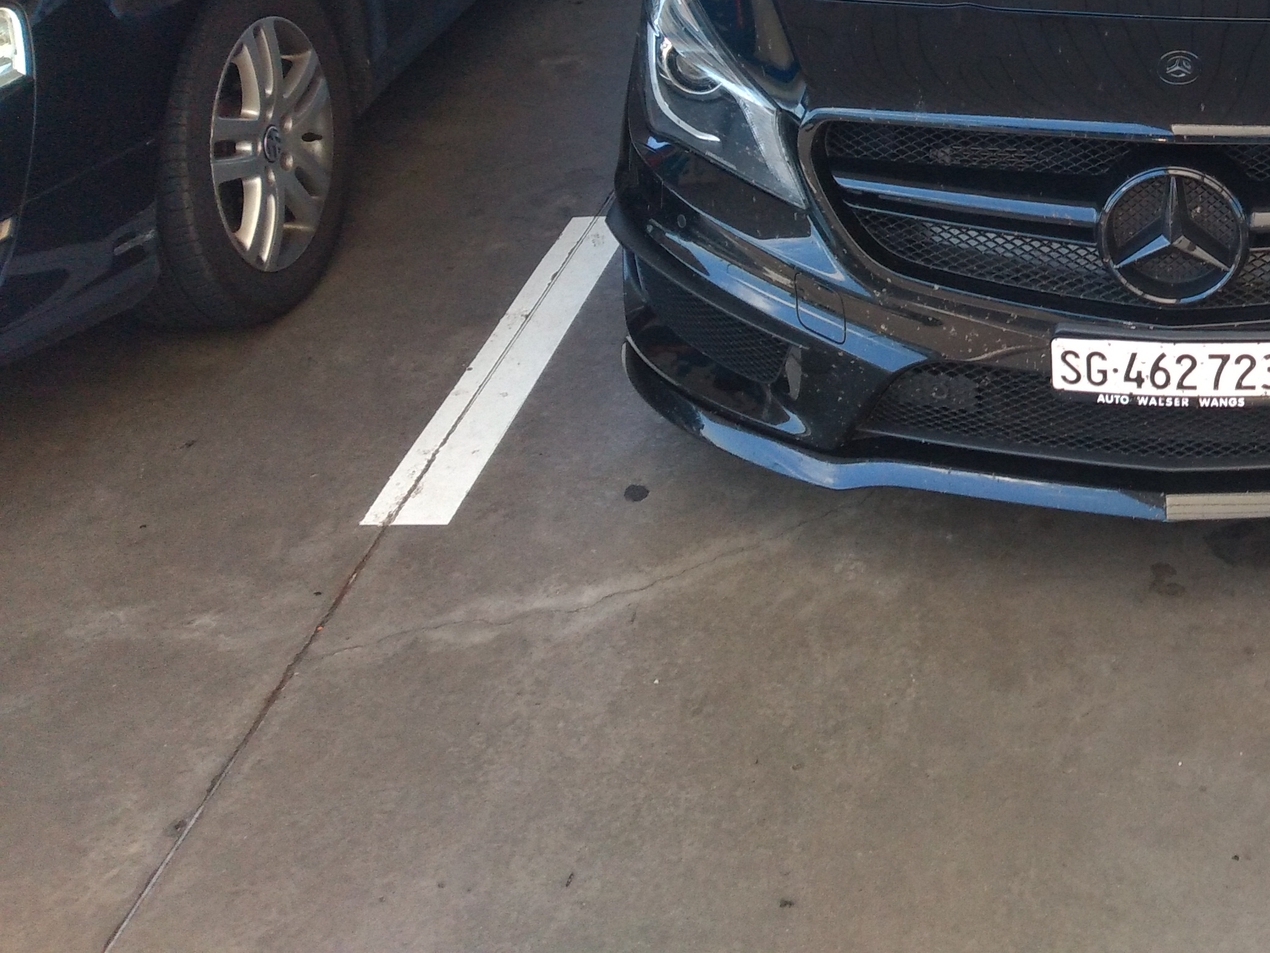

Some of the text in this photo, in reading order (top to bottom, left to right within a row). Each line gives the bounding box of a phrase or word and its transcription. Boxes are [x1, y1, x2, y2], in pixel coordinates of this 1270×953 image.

[1097, 394, 1245, 408] AUTO WALSER WANGS
